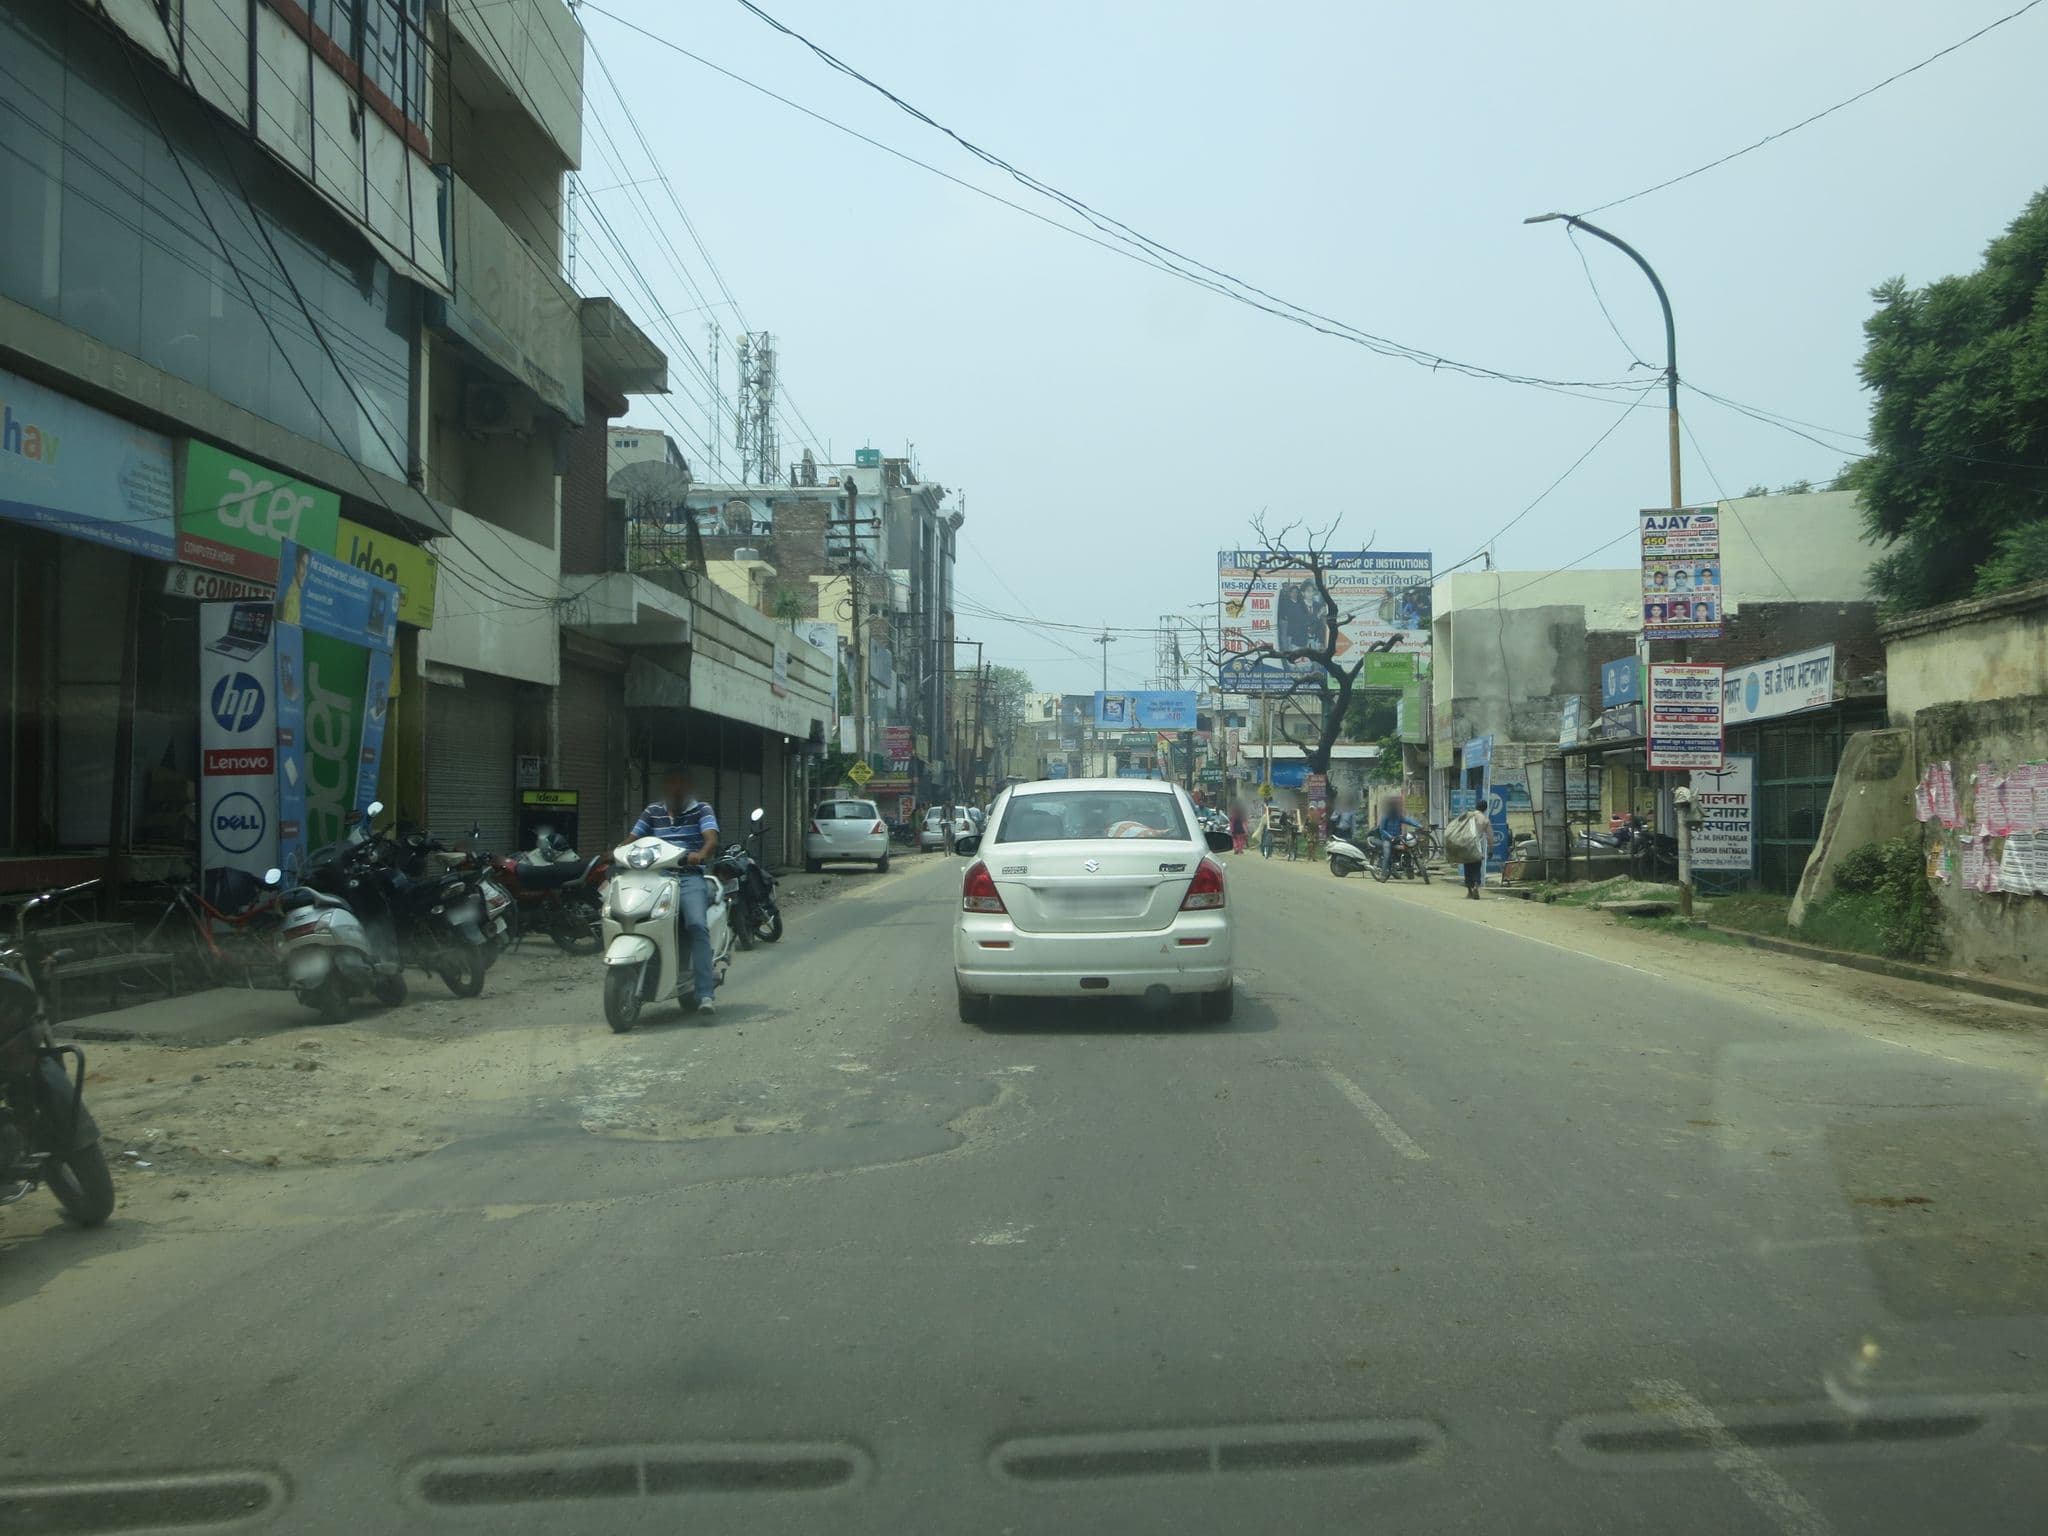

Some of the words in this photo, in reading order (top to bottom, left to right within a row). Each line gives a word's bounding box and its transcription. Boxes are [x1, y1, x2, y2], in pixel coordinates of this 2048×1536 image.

[217, 468, 314, 542] acer
[1645, 516, 1691, 530] AJAY
[1643, 537, 1666, 546] 450
[1363, 558, 1374, 569] OF
[1375, 558, 1429, 569] INSTITUTIONS
[193, 573, 275, 602] COMPUTE
[1221, 581, 1278, 591] IMS-ROORKEE
[1251, 598, 1271, 610] MBA
[1251, 619, 1271, 632] MCA
[217, 671, 257, 732] hp
[209, 751, 269, 770] Lenovo
[304, 661, 353, 853] acer
[1702, 807, 1750, 819] टनागर
[216, 815, 260, 830] DELL
[1712, 834, 1748, 842] BHATNAGAR
